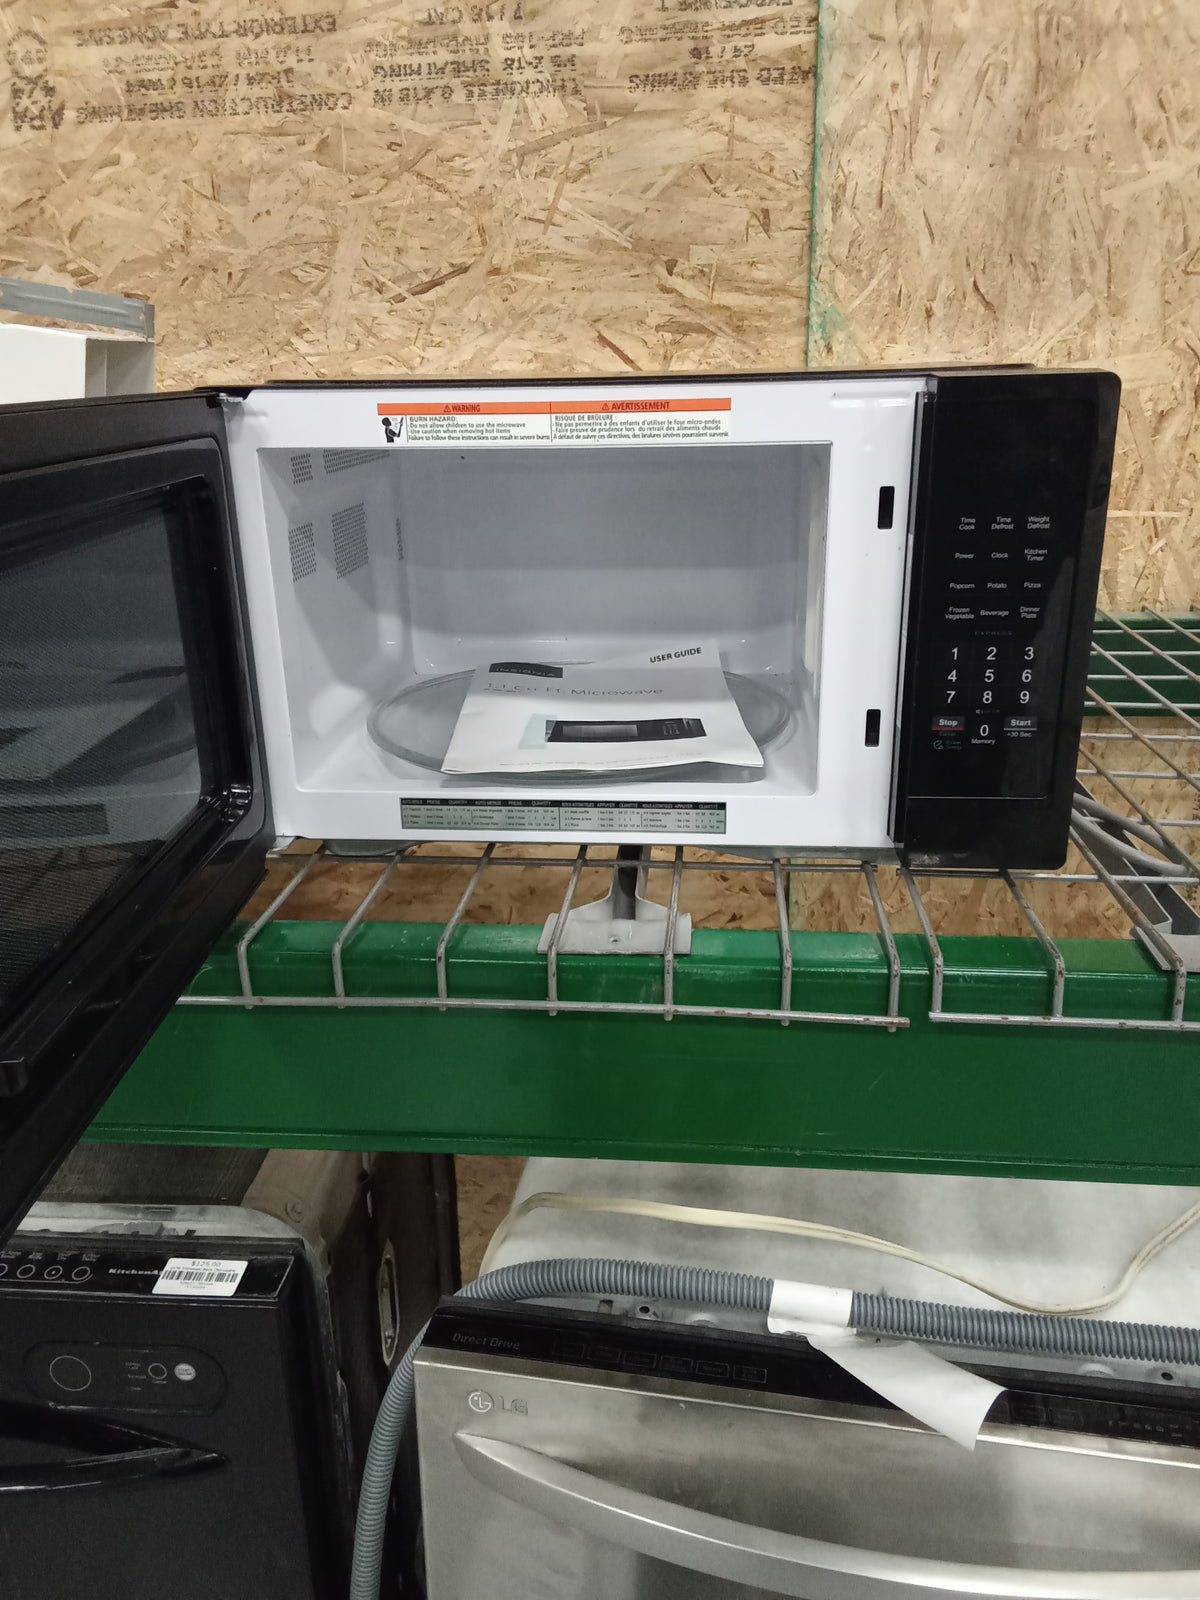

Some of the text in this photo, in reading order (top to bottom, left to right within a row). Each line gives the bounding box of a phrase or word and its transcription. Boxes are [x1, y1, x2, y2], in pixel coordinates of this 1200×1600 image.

[74, 14, 337, 47] EXTERIOR TYPE ADHESIVE
[373, 59, 490, 83] SHEATHING
[627, 68, 751, 93] SHEATHING
[464, 78, 583, 101] THICKNESS
[76, 92, 353, 124] CONSTRUCTION SHEATHING
[452, 405, 481, 413] WARNING
[611, 402, 670, 411] AVERTISSEMENT
[588, 413, 613, 421] BRÛLURE
[682, 431, 707, 439] pourraient
[1028, 516, 1050, 524] Weight
[650, 646, 702, 663] USER GUIDE
[951, 647, 959, 660] 1
[986, 646, 997, 660] 2
[1024, 646, 1034, 660] 3
[947, 669, 957, 682] 4
[984, 669, 995, 682] 5
[1022, 669, 1032, 682] 6
[571, 688, 663, 696] Microwave
[946, 690, 956, 703] 7
[982, 690, 993, 704] 8
[1020, 690, 1030, 704] 9
[938, 719, 958, 727] Stop
[980, 724, 989, 737] 0
[453, 1333, 521, 1350] Direct Drive
